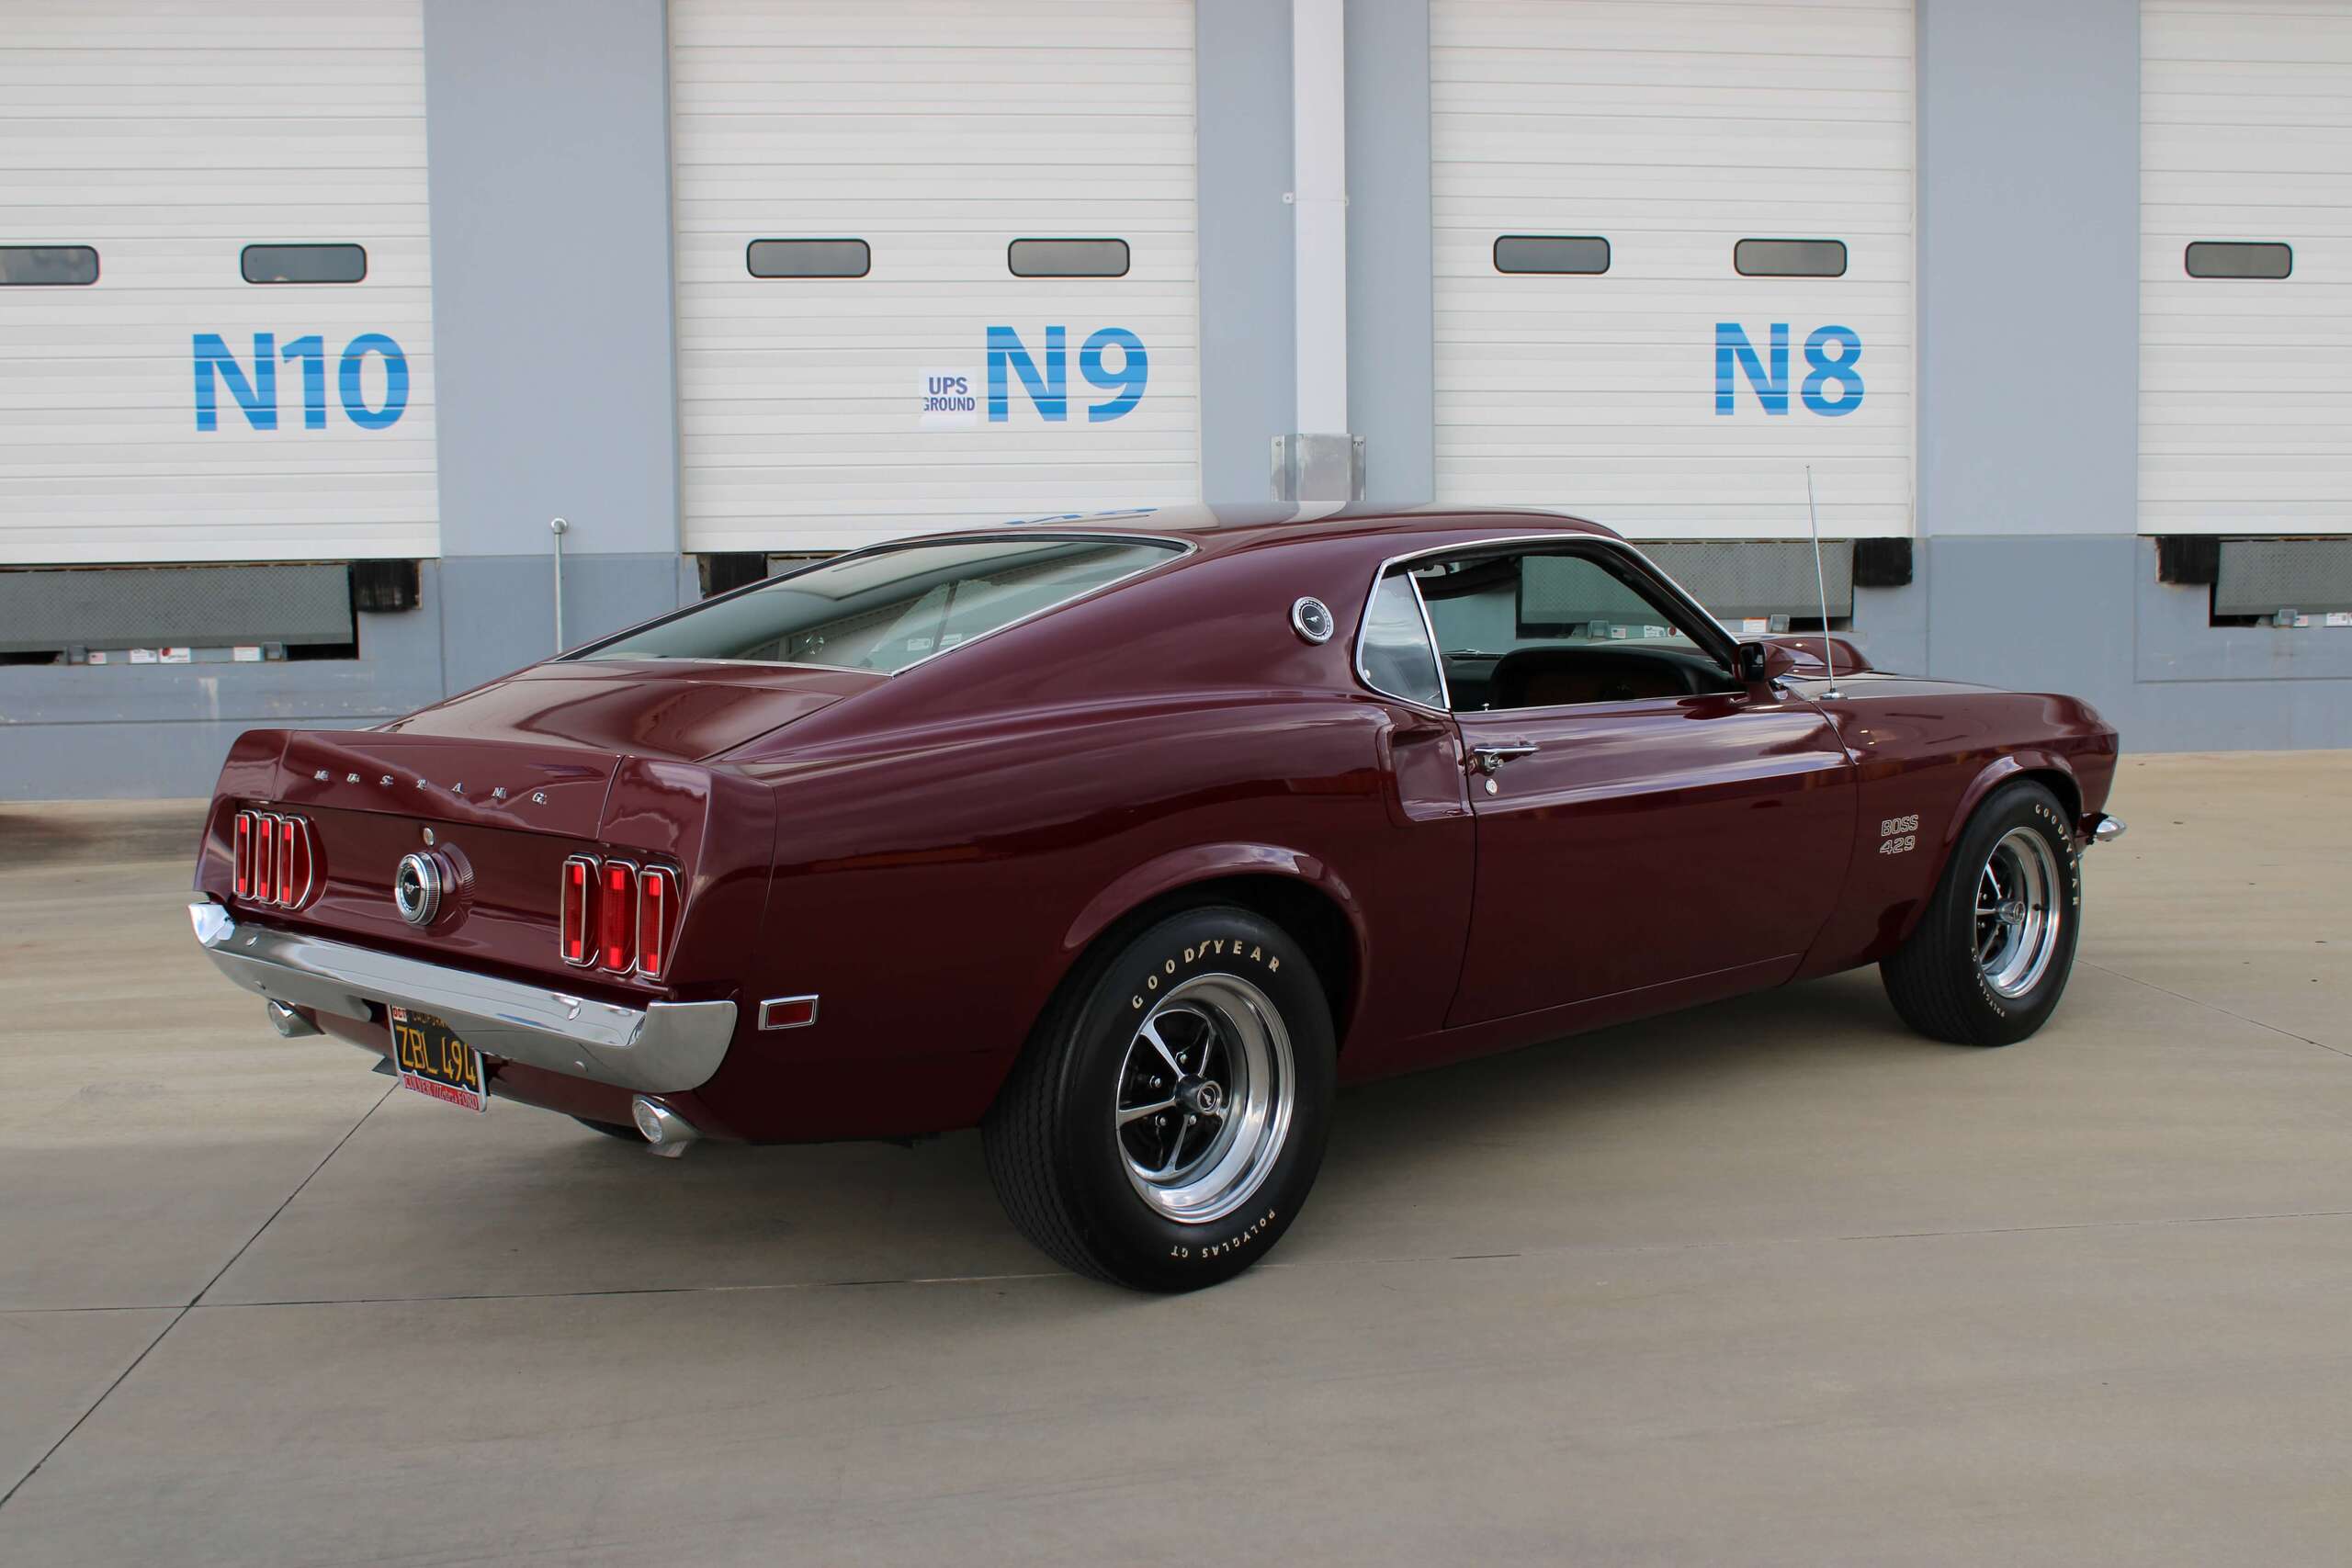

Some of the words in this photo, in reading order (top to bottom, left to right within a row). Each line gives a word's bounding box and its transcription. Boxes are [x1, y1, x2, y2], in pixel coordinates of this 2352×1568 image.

[193, 333, 409, 431] N10
[929, 377, 967, 395] UPS
[987, 326, 1148, 423] N9
[1715, 323, 1864, 416] N8
[923, 397, 975, 412] GROUND
[314, 770, 547, 805] MUSTANG
[1880, 835, 1916, 854] 429
[1881, 814, 1918, 837] BOSS
[1132, 940, 1280, 1009] GOODYEAR
[396, 1026, 437, 1074] ZBL
[442, 1036, 477, 1086] 494
[1170, 1246, 1188, 1258] GT
[1202, 1209, 1275, 1258] POLYGLAS
